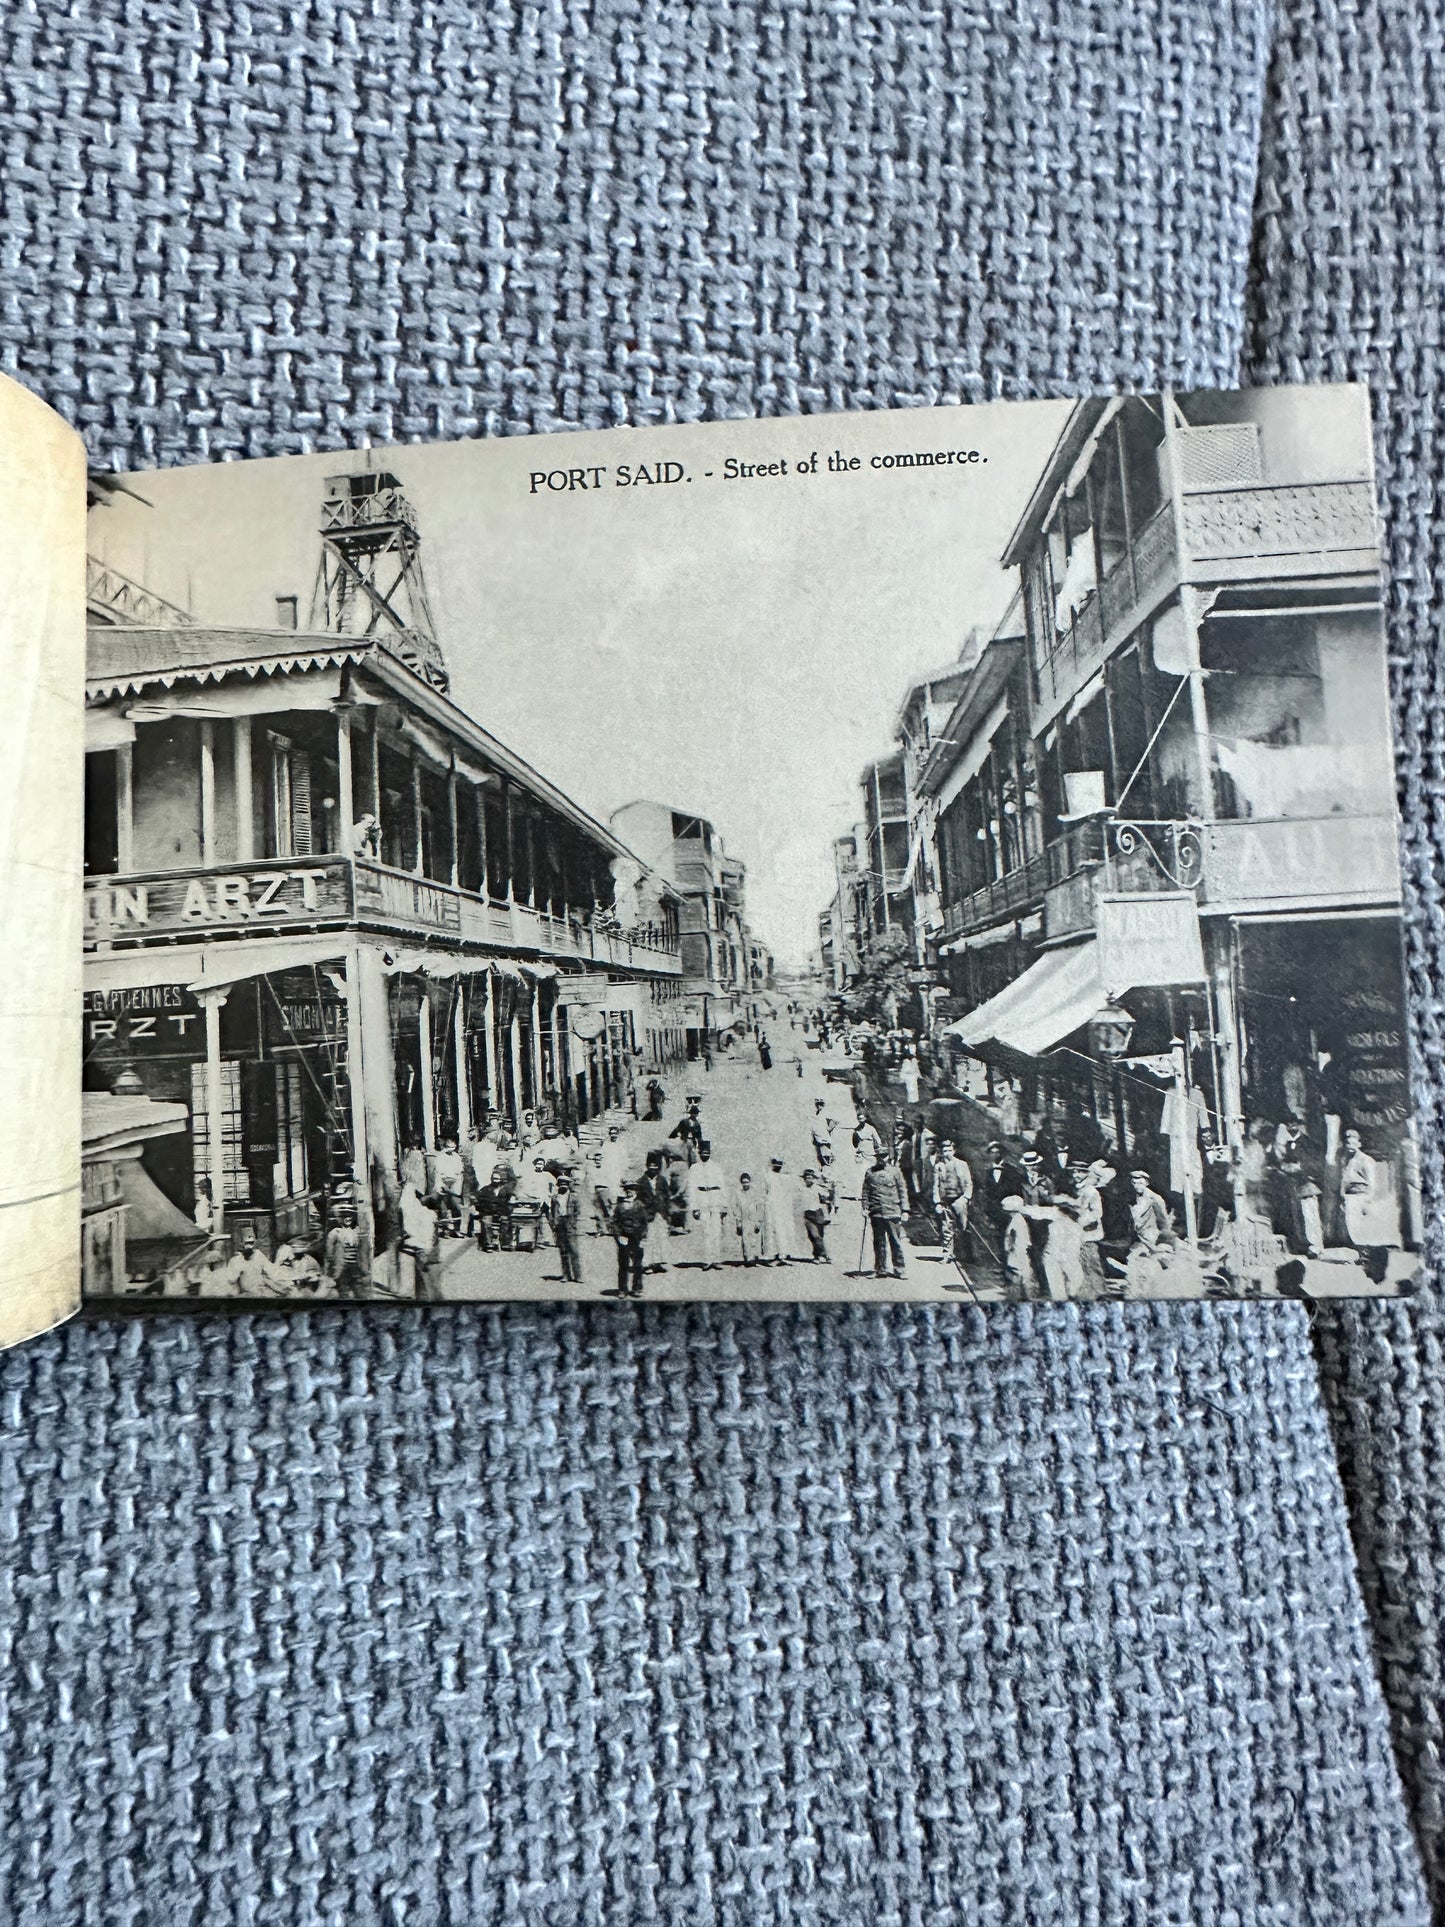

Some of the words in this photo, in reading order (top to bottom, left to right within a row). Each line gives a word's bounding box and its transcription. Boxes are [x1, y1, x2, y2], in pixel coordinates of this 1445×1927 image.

[529, 466, 607, 494] PORT
[616, 461, 692, 487] SAID.
[723, 458, 788, 480] Street
[796, 452, 818, 474] of
[828, 450, 861, 472] the
[870, 449, 989, 470] commerce.
[180, 868, 327, 922] ARZT
[90, 1014, 197, 1040] RZT
